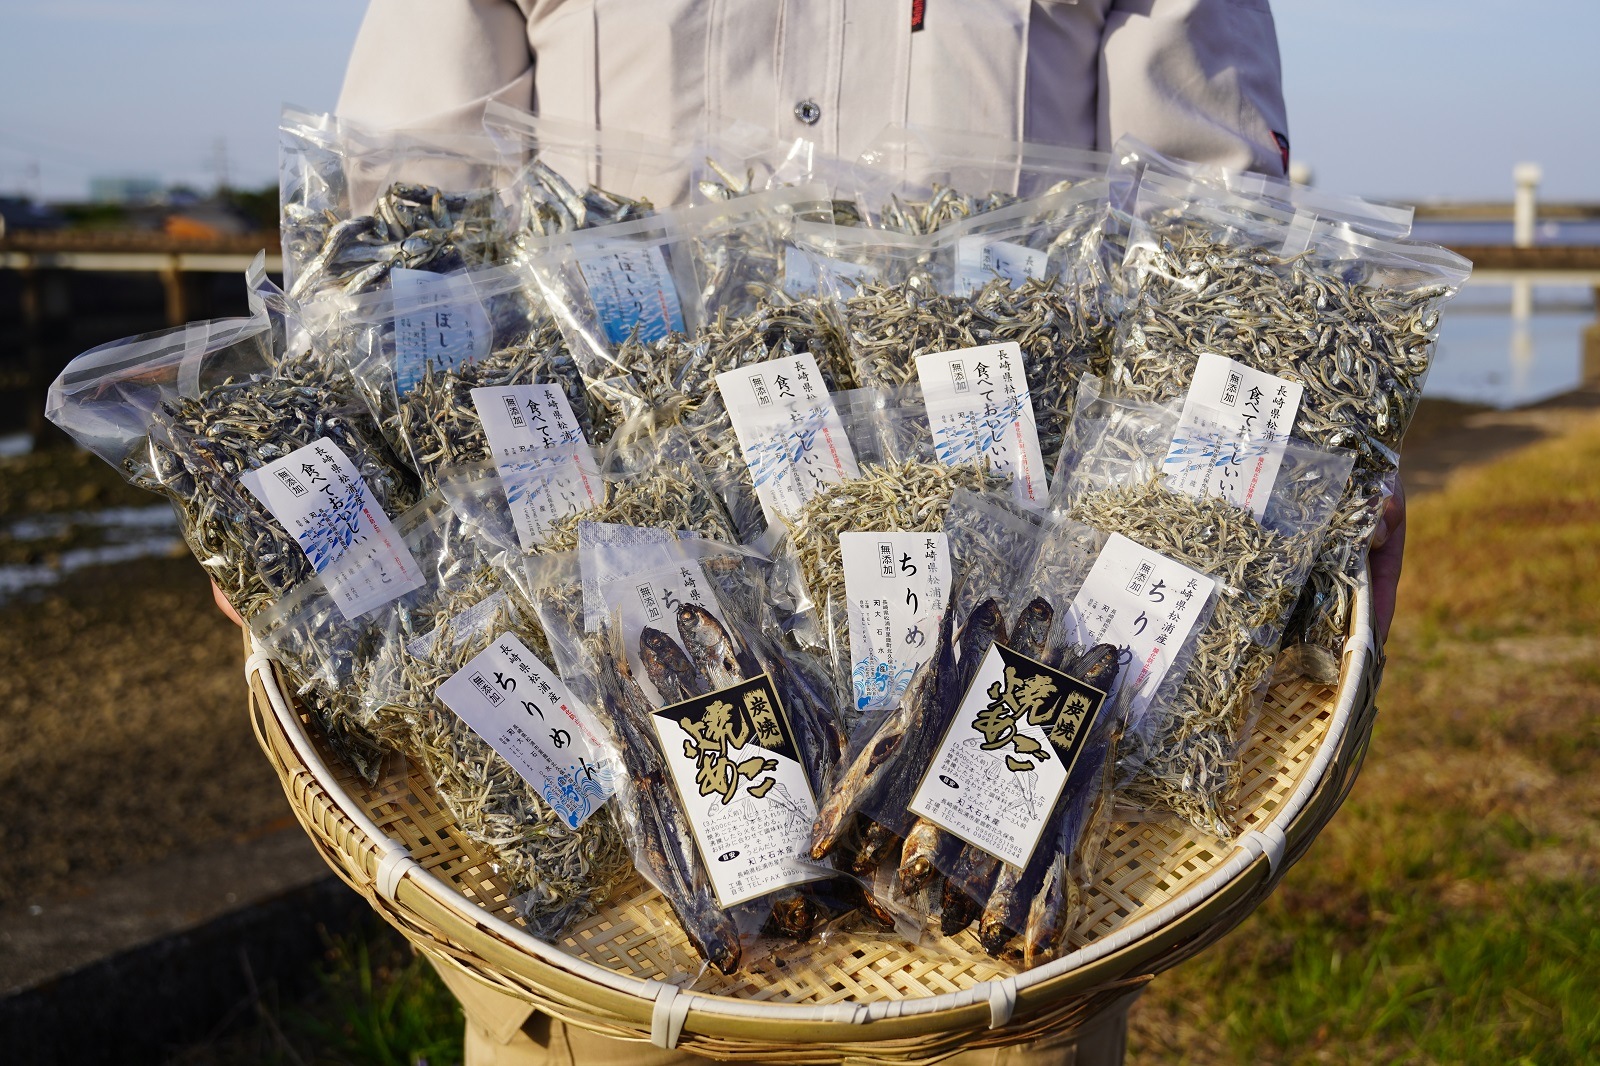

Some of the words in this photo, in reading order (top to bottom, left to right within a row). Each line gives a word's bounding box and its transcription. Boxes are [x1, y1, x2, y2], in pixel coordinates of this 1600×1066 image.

[751, 377, 771, 405] 無添加
[951, 363, 967, 390] 無添加
[996, 350, 1022, 418] 長崎県松浦産
[1223, 373, 1241, 404] 無添加
[505, 397, 524, 426] 無添加
[276, 470, 304, 495] 無添加
[315, 446, 366, 506] 長崎県松浦産
[880, 544, 895, 575] 無添加
[924, 538, 943, 611] 長崎県松浦産
[1129, 562, 1152, 593] 無添加
[639, 586, 660, 618] 無添加
[1155, 578, 1198, 646] 長崎県松浦産
[472, 674, 502, 704] 無添加
[500, 644, 561, 705] 長崎県松浦産
[749, 695, 781, 740] 炭焼
[1053, 698, 1086, 742] 炭焼
